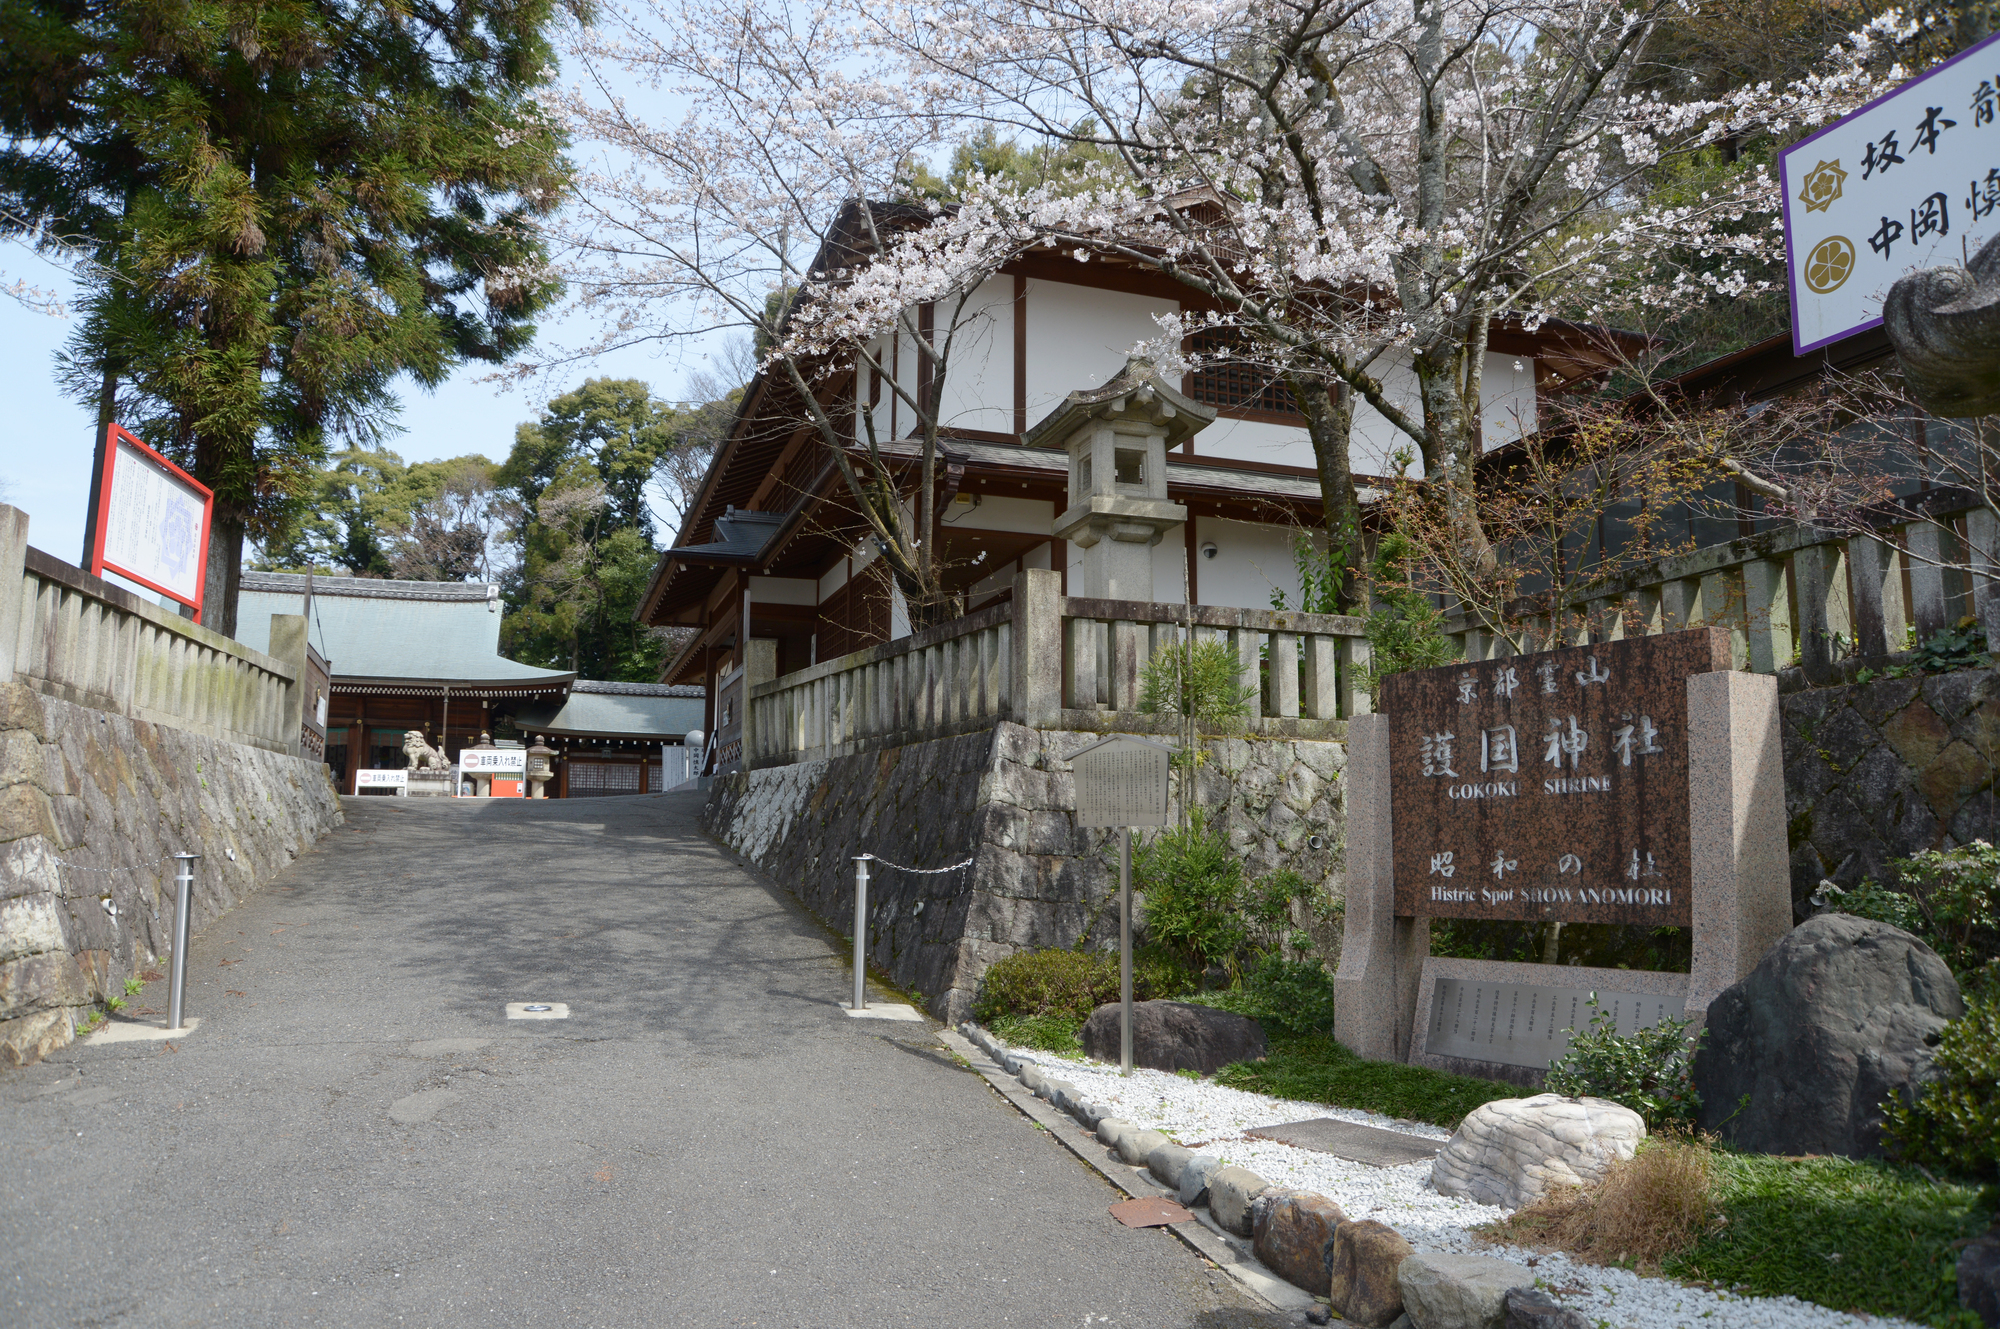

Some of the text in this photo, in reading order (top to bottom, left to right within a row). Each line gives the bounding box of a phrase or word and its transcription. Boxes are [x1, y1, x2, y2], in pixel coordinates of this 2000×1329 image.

[1456, 655, 1610, 704] 京都霊山
[1419, 711, 1663, 778] 護国神社
[480, 756, 522, 767] 車両乗入れ禁止
[1448, 775, 1612, 799] GOKOKU SHRINE
[1429, 848, 1662, 880] 昭和の杜
[1431, 886, 1476, 901] Histric
[1482, 886, 1514, 905] Spot
